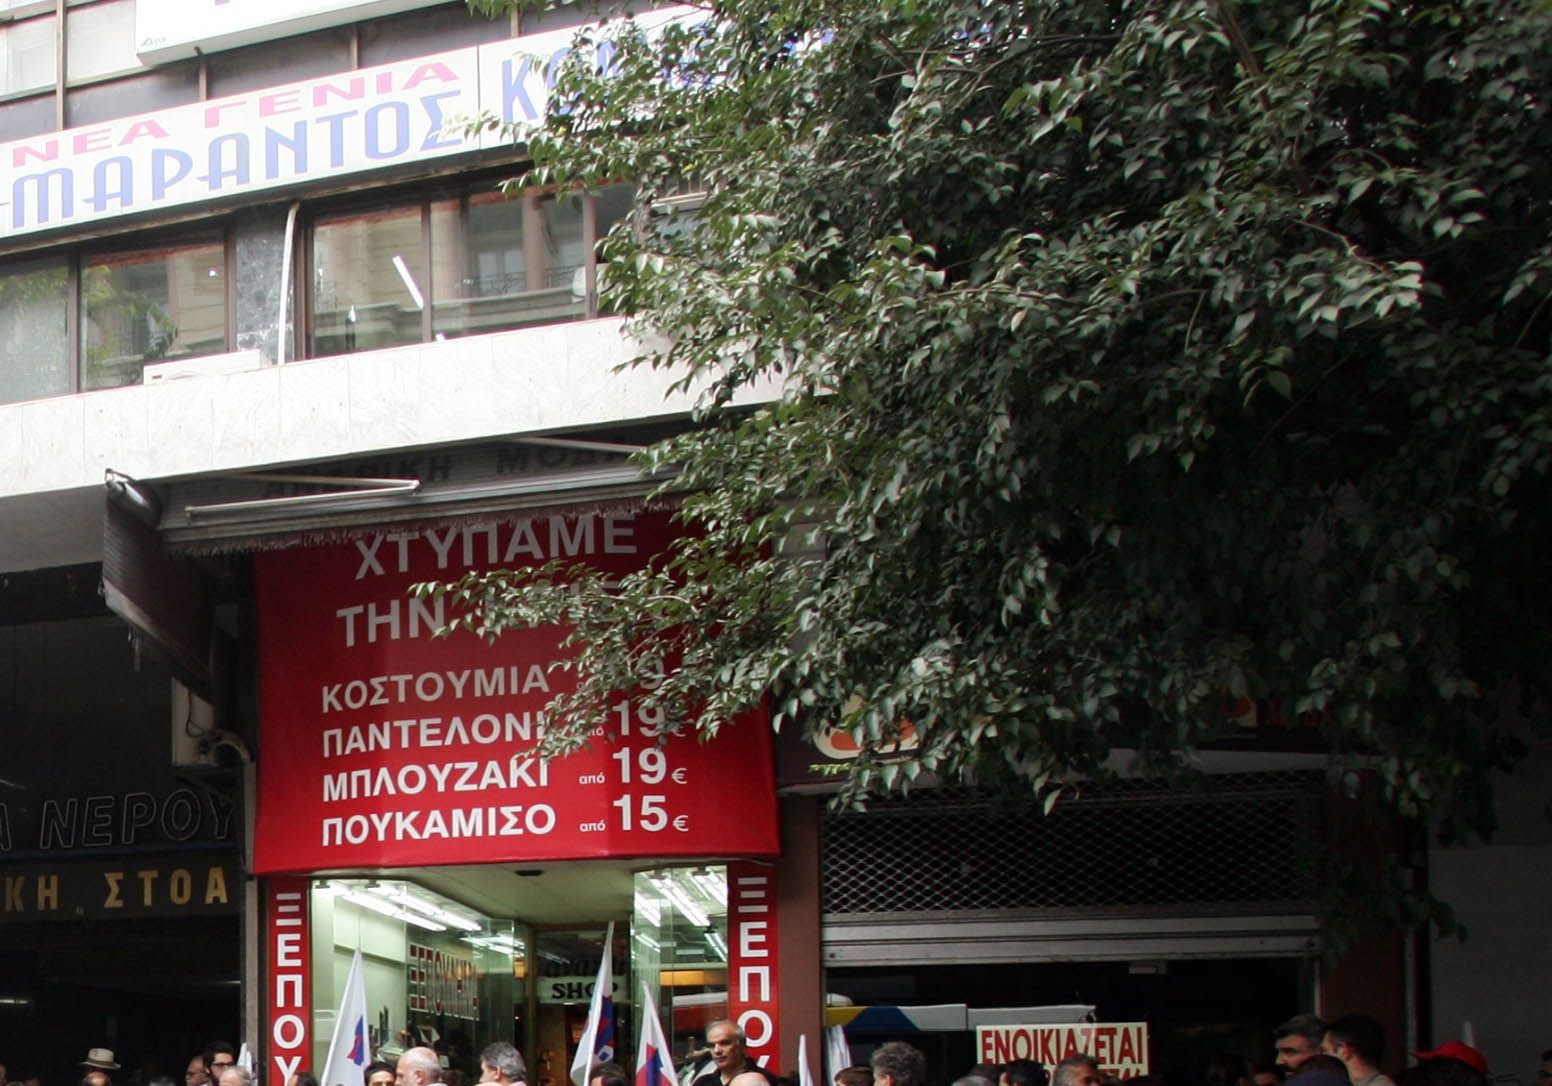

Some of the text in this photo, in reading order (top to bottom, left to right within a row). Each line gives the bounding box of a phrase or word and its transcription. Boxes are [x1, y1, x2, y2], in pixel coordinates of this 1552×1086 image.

[12, 118, 170, 168] ΝΕΑ
[203, 61, 460, 129] ΓΕΝΙΑ
[355, 513, 638, 580] ΧΤΥΠΑΜΕ
[337, 597, 446, 647] ΤΗΝ
[322, 664, 549, 713] ΚΟΣΤΟΥΜΙΑ
[322, 757, 549, 802] ΜΠΛΟΥΖΑΚΙ
[579, 772, 606, 785] από
[39, 788, 236, 850] ΝΕΡΟΥ
[321, 803, 556, 846] ΠΟΥΚΑΜΙΣΟ
[579, 819, 606, 833] από
[103, 867, 228, 909] ΣΤΟΑ
[737, 876, 773, 1068] ΞΕΠΟ
